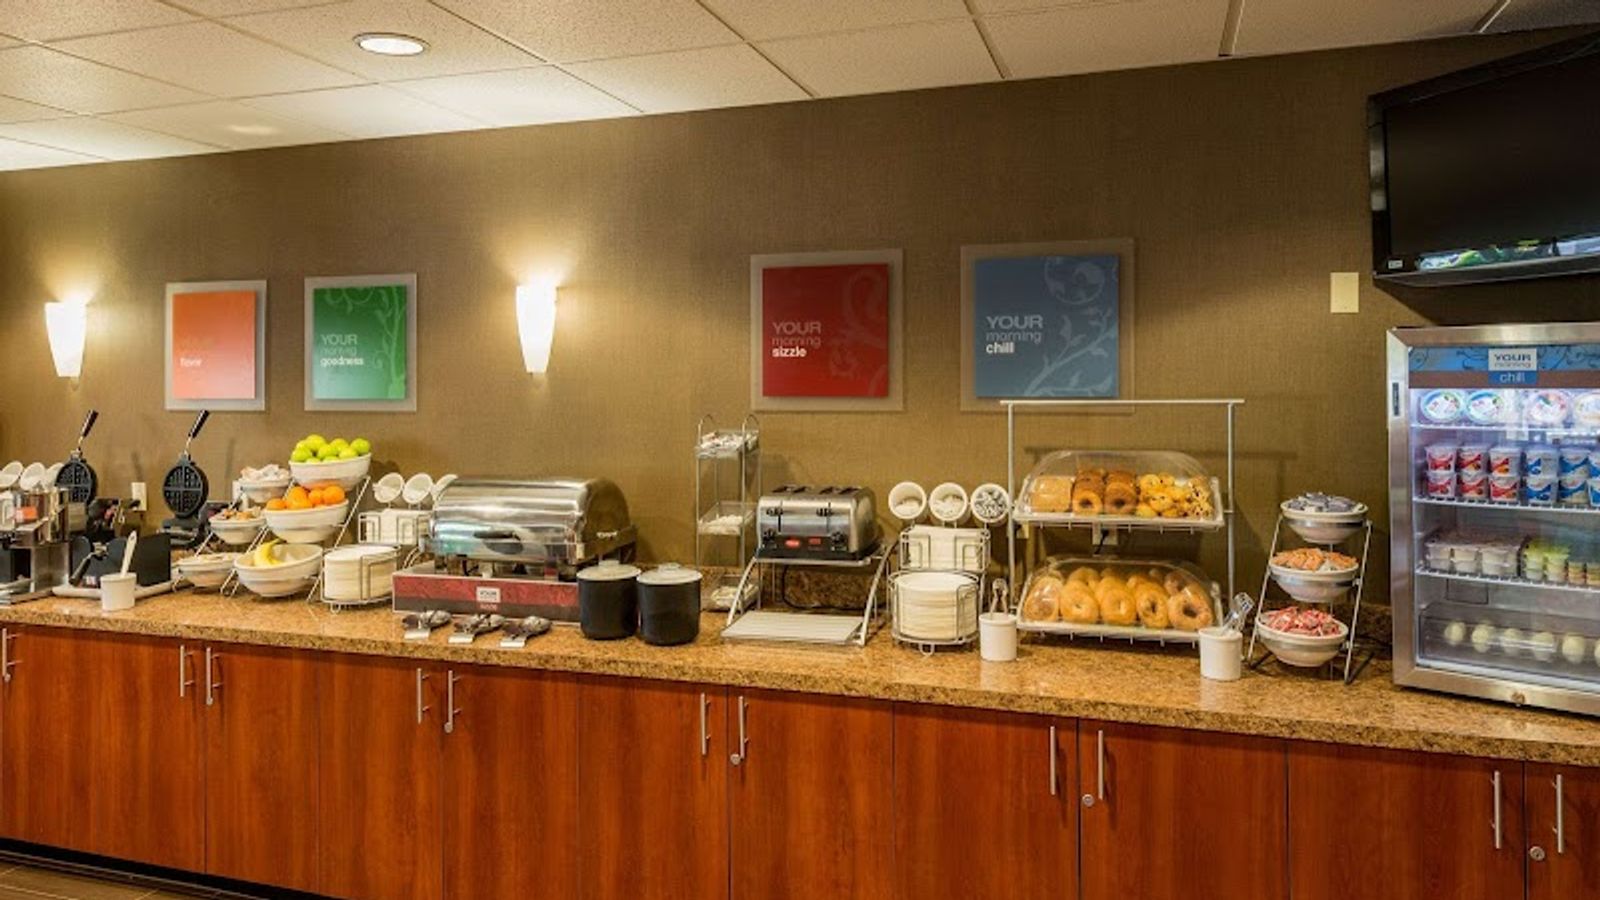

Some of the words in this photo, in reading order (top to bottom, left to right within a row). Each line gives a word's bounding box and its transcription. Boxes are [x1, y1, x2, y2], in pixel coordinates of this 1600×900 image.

[772, 320, 822, 335] YOUR
[985, 315, 1044, 329] YOUR
[320, 334, 358, 345] YOUR
[771, 336, 822, 349] morning
[986, 331, 1043, 344] morning
[772, 347, 808, 357] sizzle
[985, 342, 1016, 354] chill
[320, 356, 364, 367] goodness
[1494, 353, 1532, 361] YOUR
[1499, 372, 1526, 383] chill
